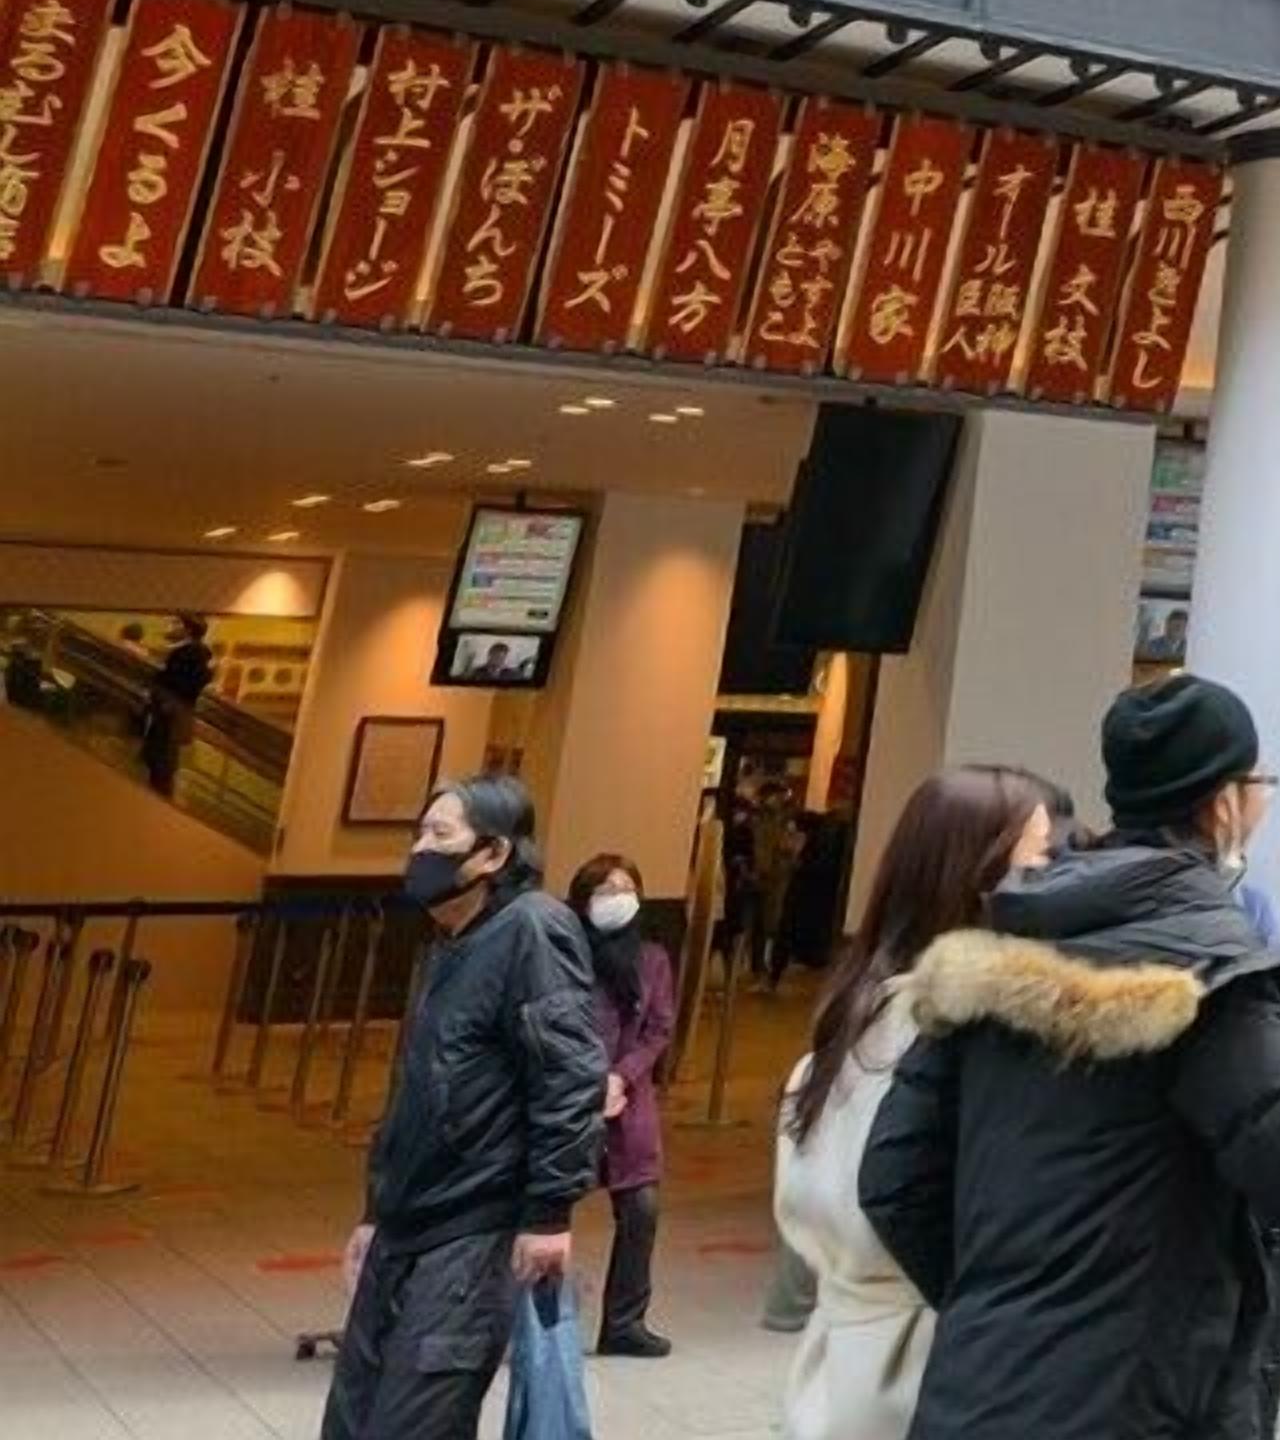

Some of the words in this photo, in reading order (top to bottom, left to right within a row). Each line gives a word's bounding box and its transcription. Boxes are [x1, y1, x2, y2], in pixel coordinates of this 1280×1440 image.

[100, 24, 211, 269] 今くるよ
[344, 60, 450, 300] 村上ショージ
[565, 107, 648, 313] トミーズ
[668, 119, 754, 332] 月亭八方
[869, 160, 943, 344] 中川家
